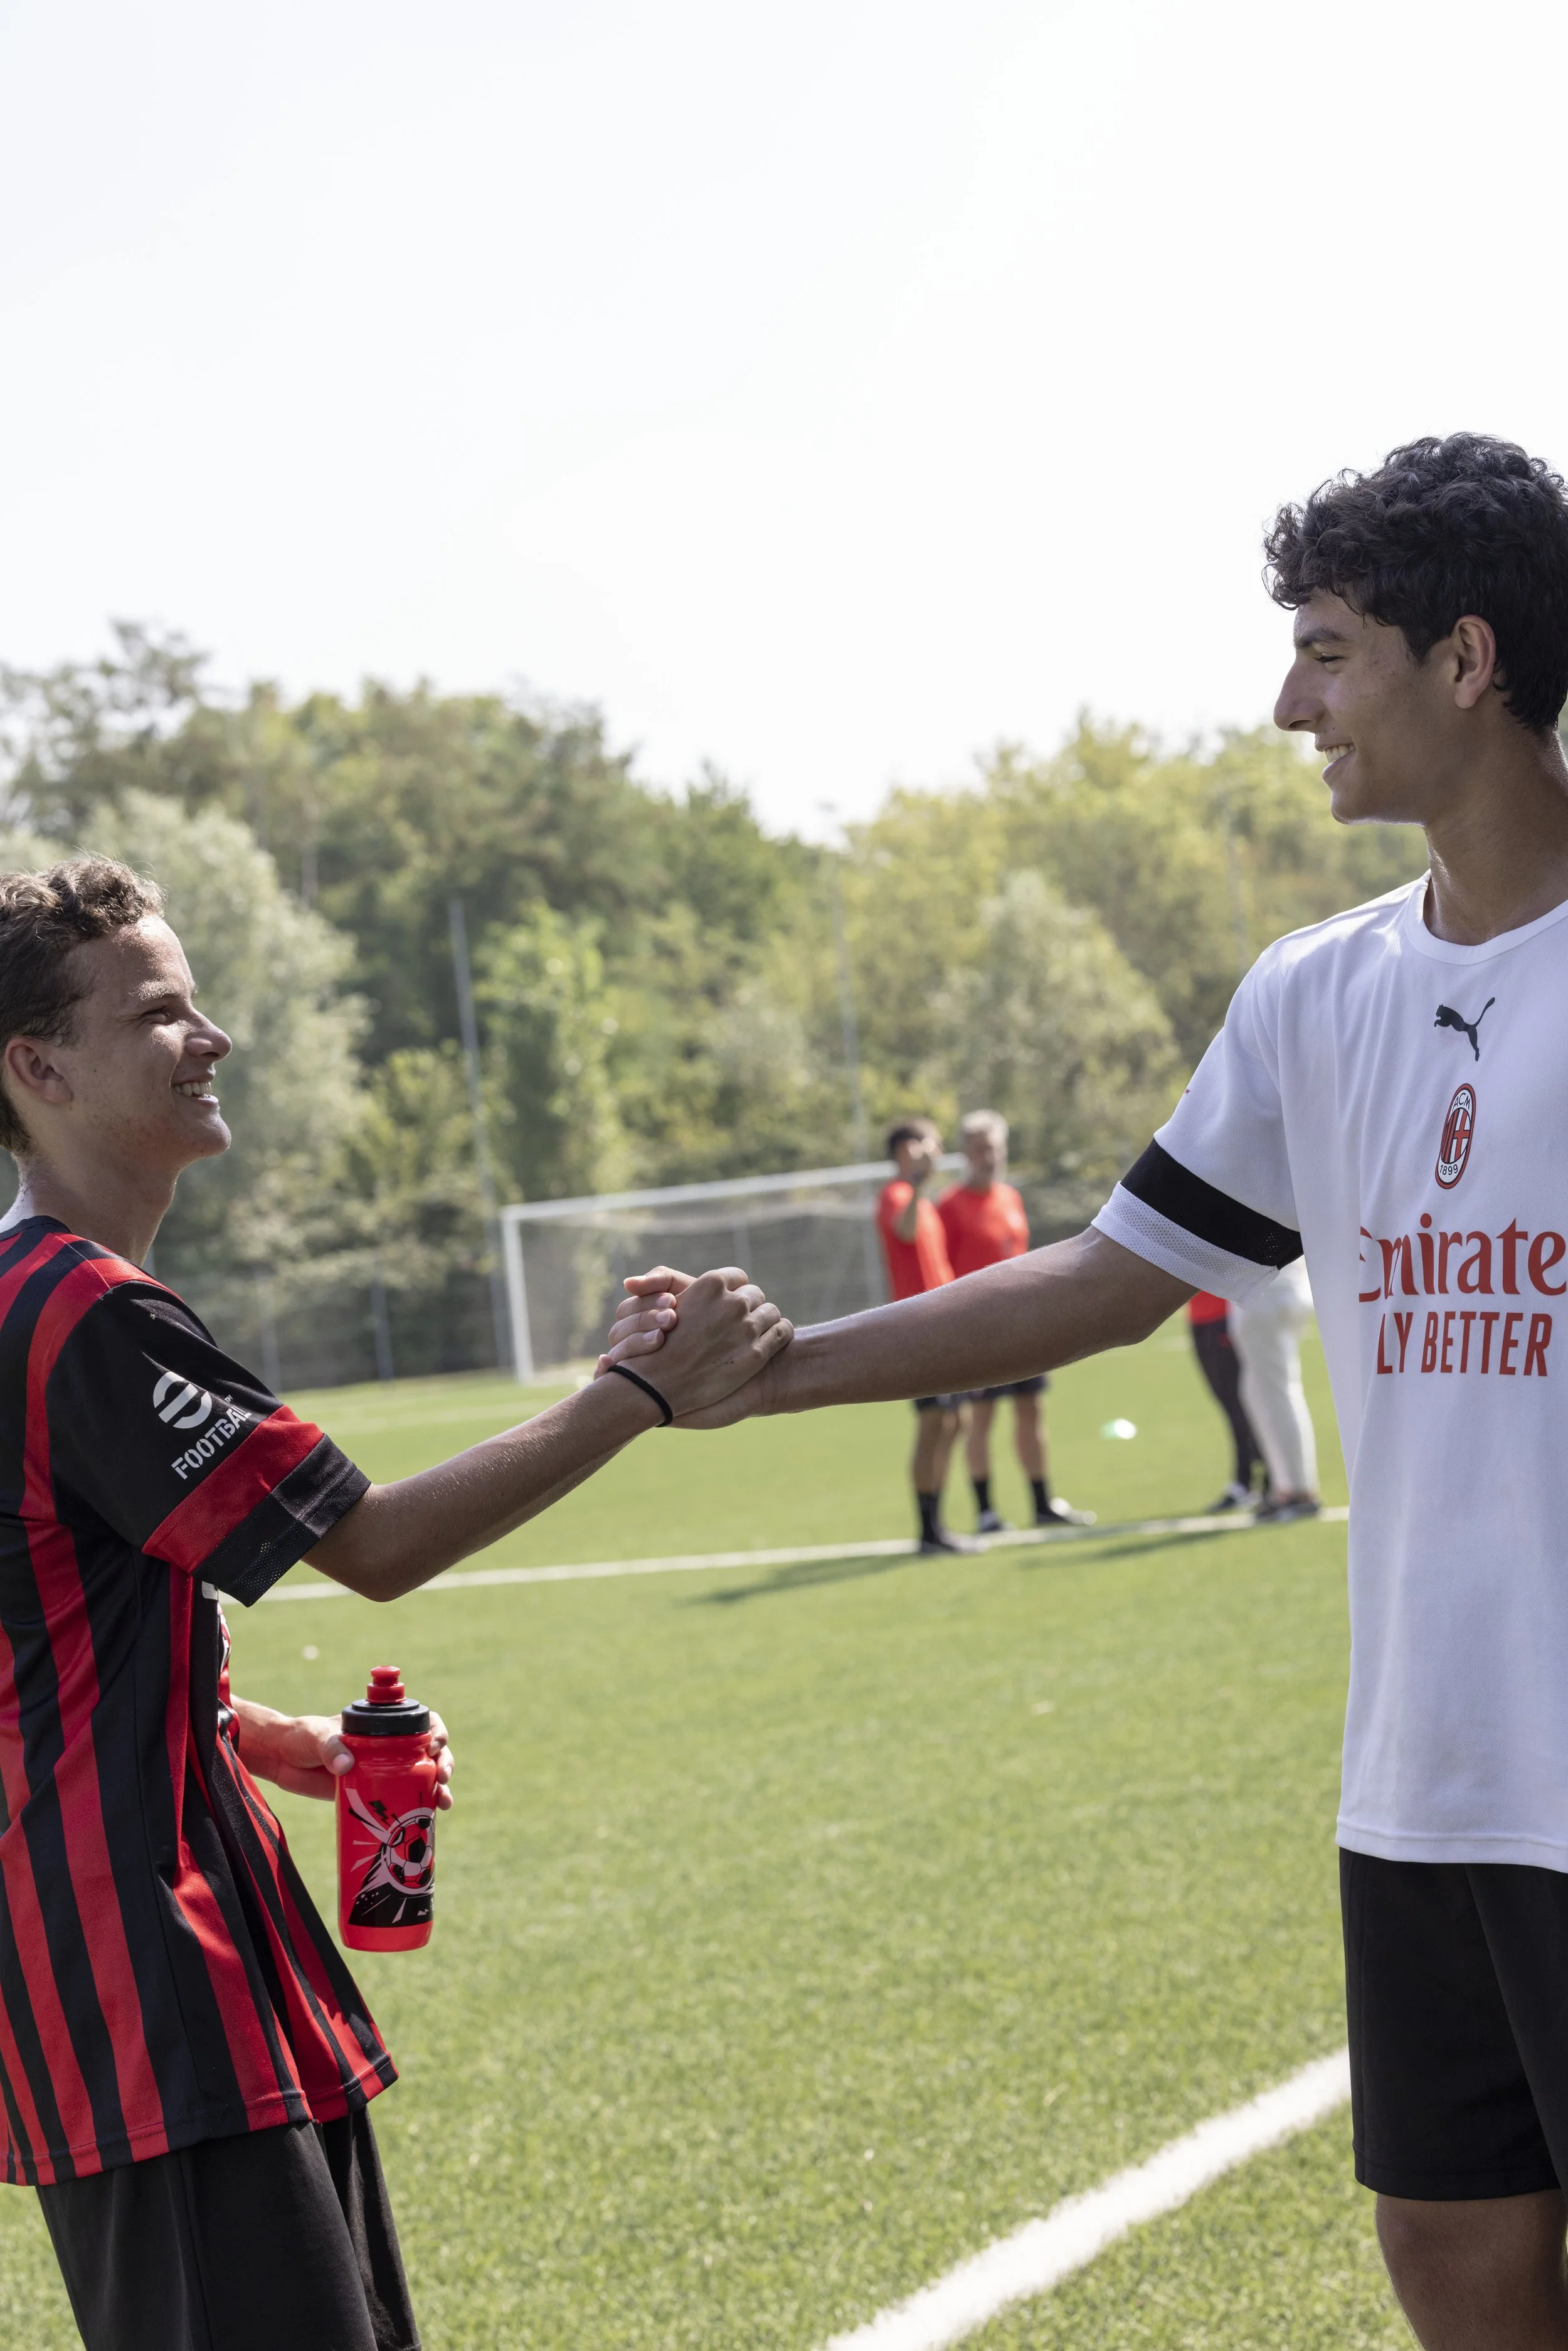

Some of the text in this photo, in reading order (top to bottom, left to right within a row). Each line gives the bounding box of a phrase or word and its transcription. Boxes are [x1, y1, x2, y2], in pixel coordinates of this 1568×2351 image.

[1452, 1092, 1471, 1112] ACM
[1439, 1164, 1459, 1176] 1899
[1421, 1310, 1553, 1377] BETTER
